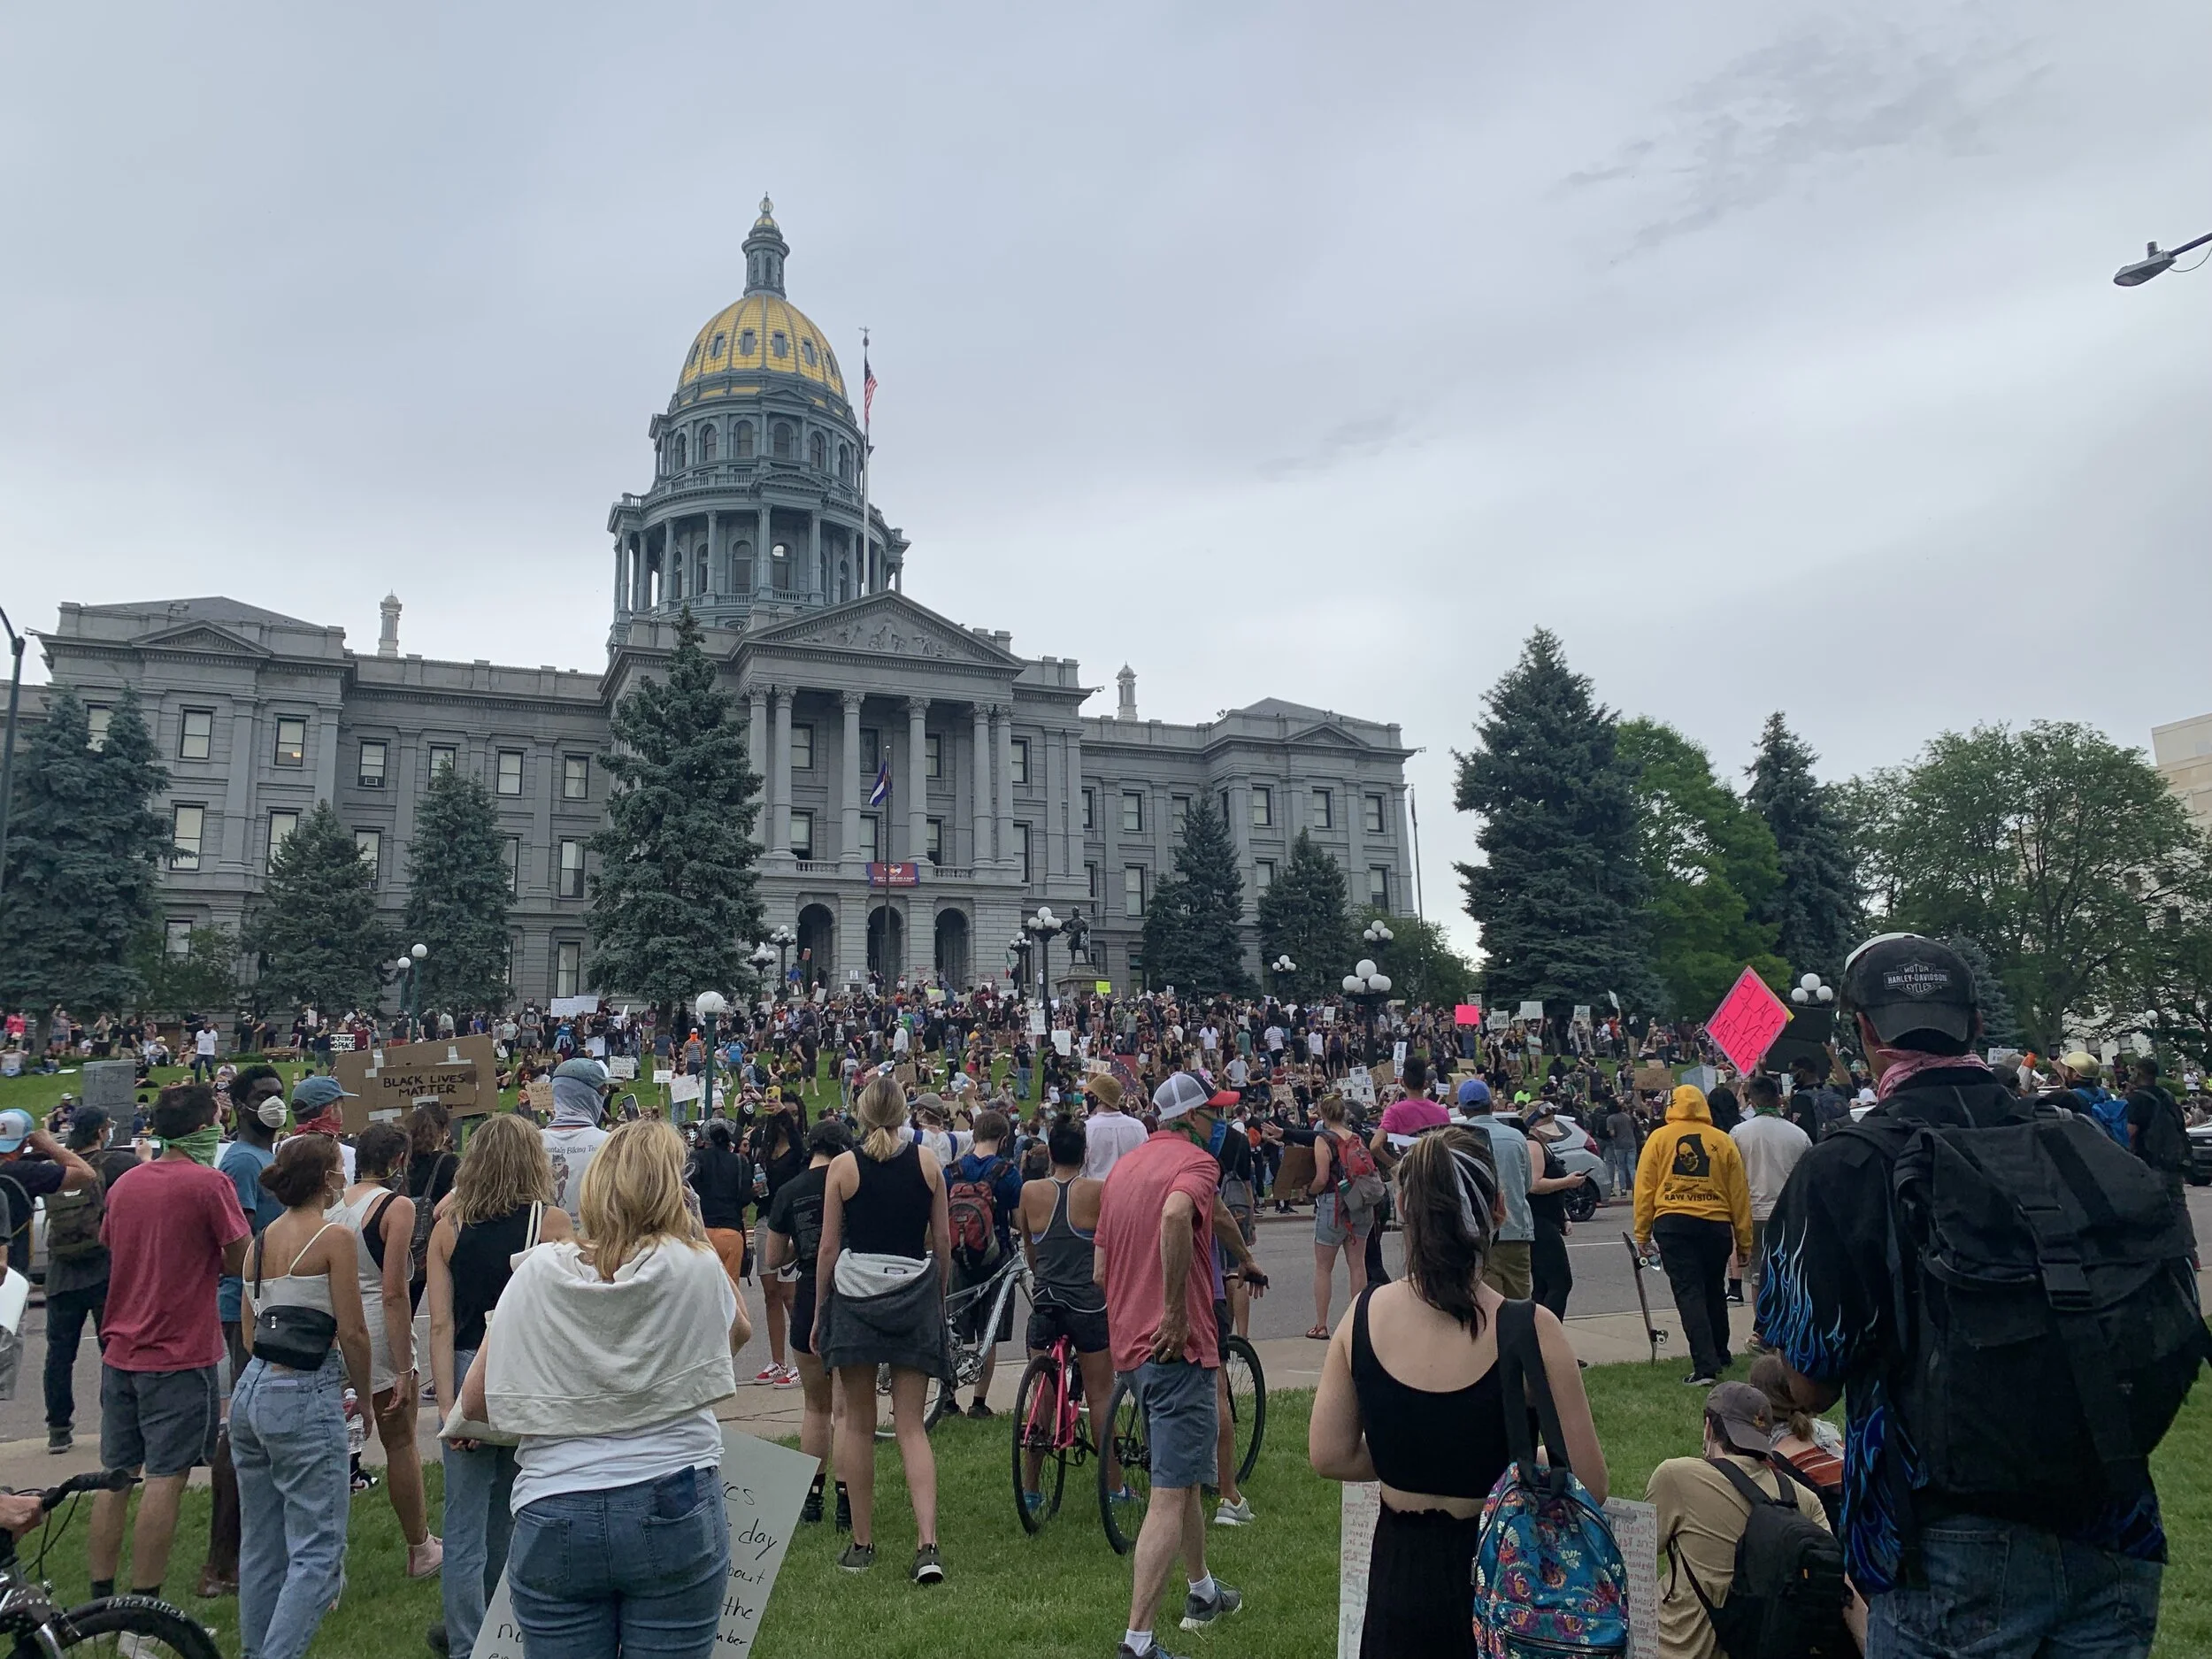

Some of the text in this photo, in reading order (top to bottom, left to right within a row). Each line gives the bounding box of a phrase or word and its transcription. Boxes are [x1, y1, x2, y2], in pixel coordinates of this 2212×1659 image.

[1887, 973, 1947, 984] HARLEY-DAVIDSON
[1903, 964, 1929, 973] MOTOR
[1906, 983, 1932, 993] CYCLES
[1737, 975, 1781, 1030] BLACK
[1722, 992, 1777, 1048] LIVES
[1709, 1011, 1758, 1069] MATTER
[383, 1073, 465, 1088] BLACK LIVES
[399, 1085, 457, 1097] MATTER
[723, 1482, 755, 1506] es
[738, 1518, 777, 1561] day
[727, 1559, 765, 1585] bout
[723, 1596, 753, 1619] the
